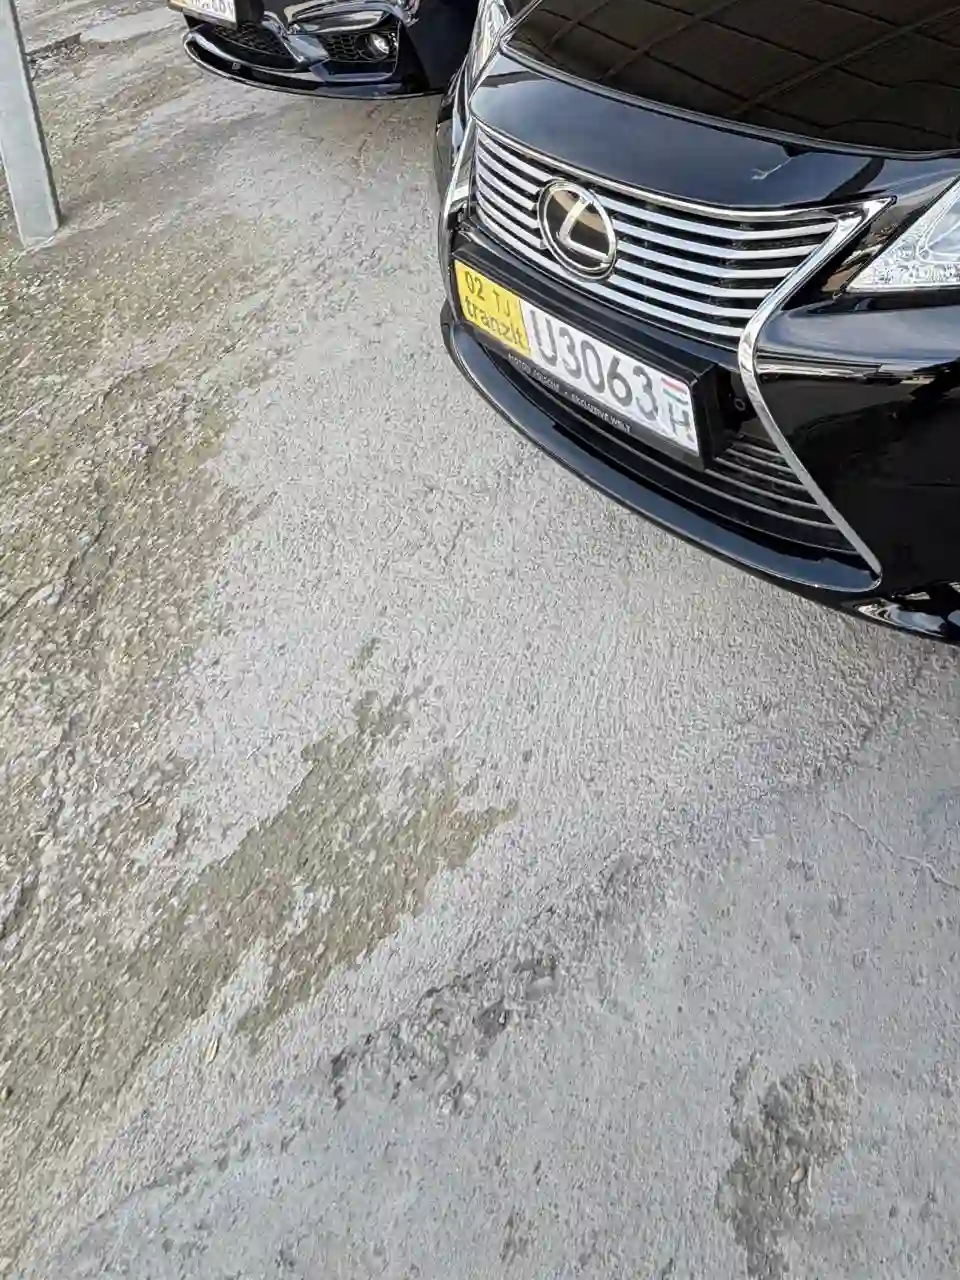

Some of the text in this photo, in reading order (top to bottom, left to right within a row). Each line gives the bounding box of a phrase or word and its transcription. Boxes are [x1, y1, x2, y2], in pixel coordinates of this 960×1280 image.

[465, 270, 511, 318] 02 TJ
[529, 309, 660, 422] U3063
